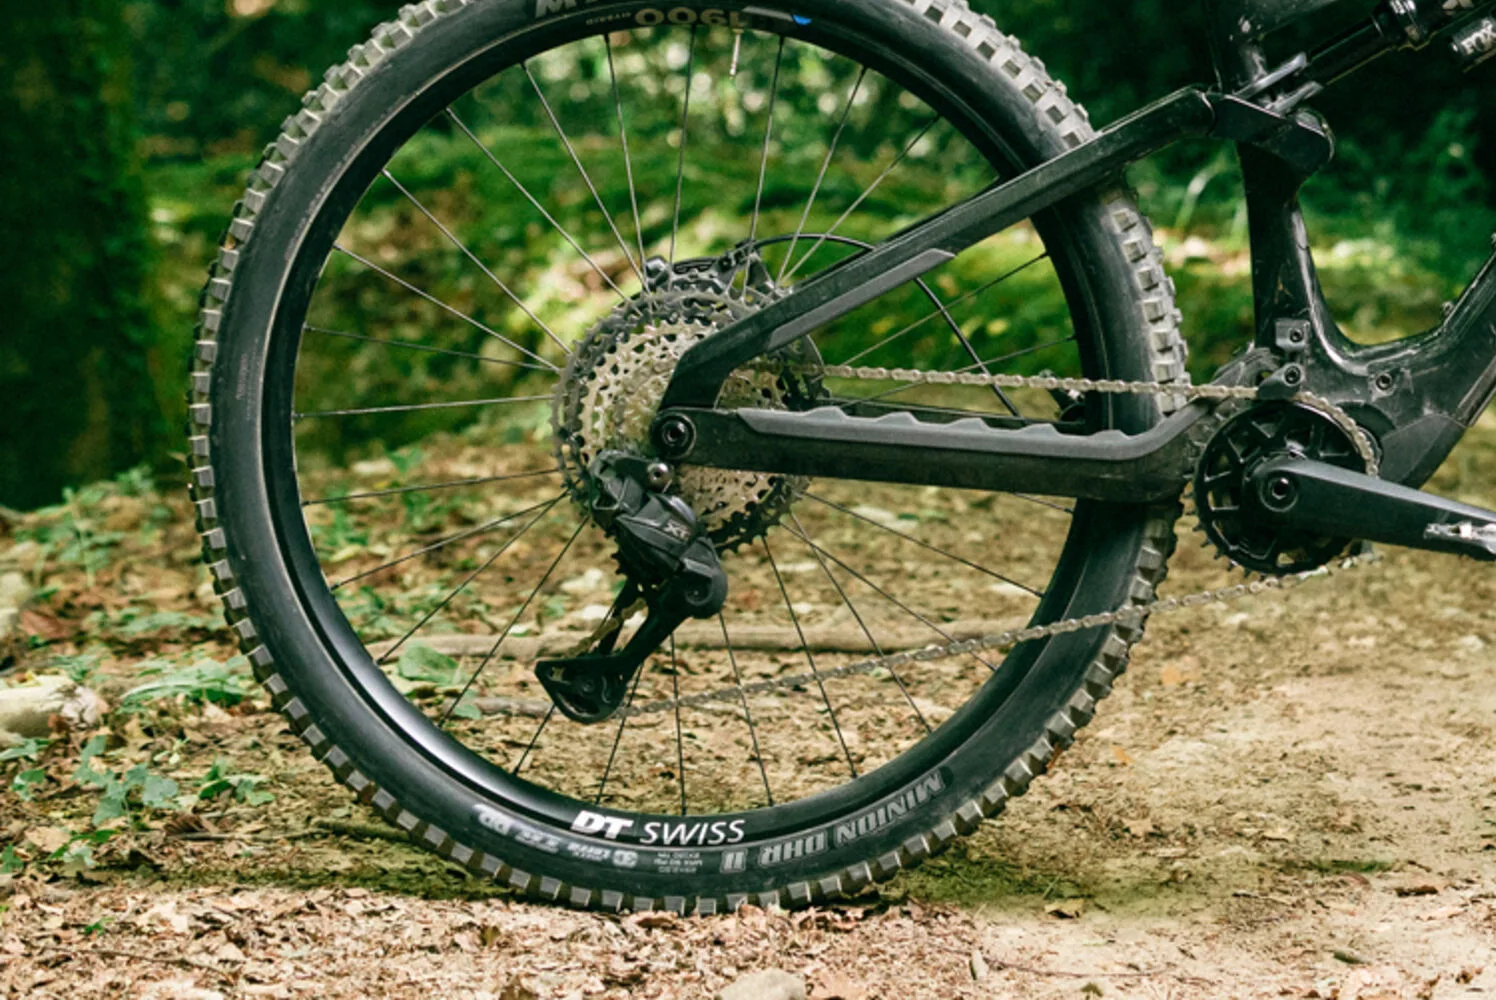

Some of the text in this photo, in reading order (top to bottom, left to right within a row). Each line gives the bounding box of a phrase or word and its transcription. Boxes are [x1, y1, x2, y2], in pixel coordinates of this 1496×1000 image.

[835, 772, 943, 845] MINION
[571, 810, 745, 846] DT SWISS
[760, 832, 826, 866] DHR
